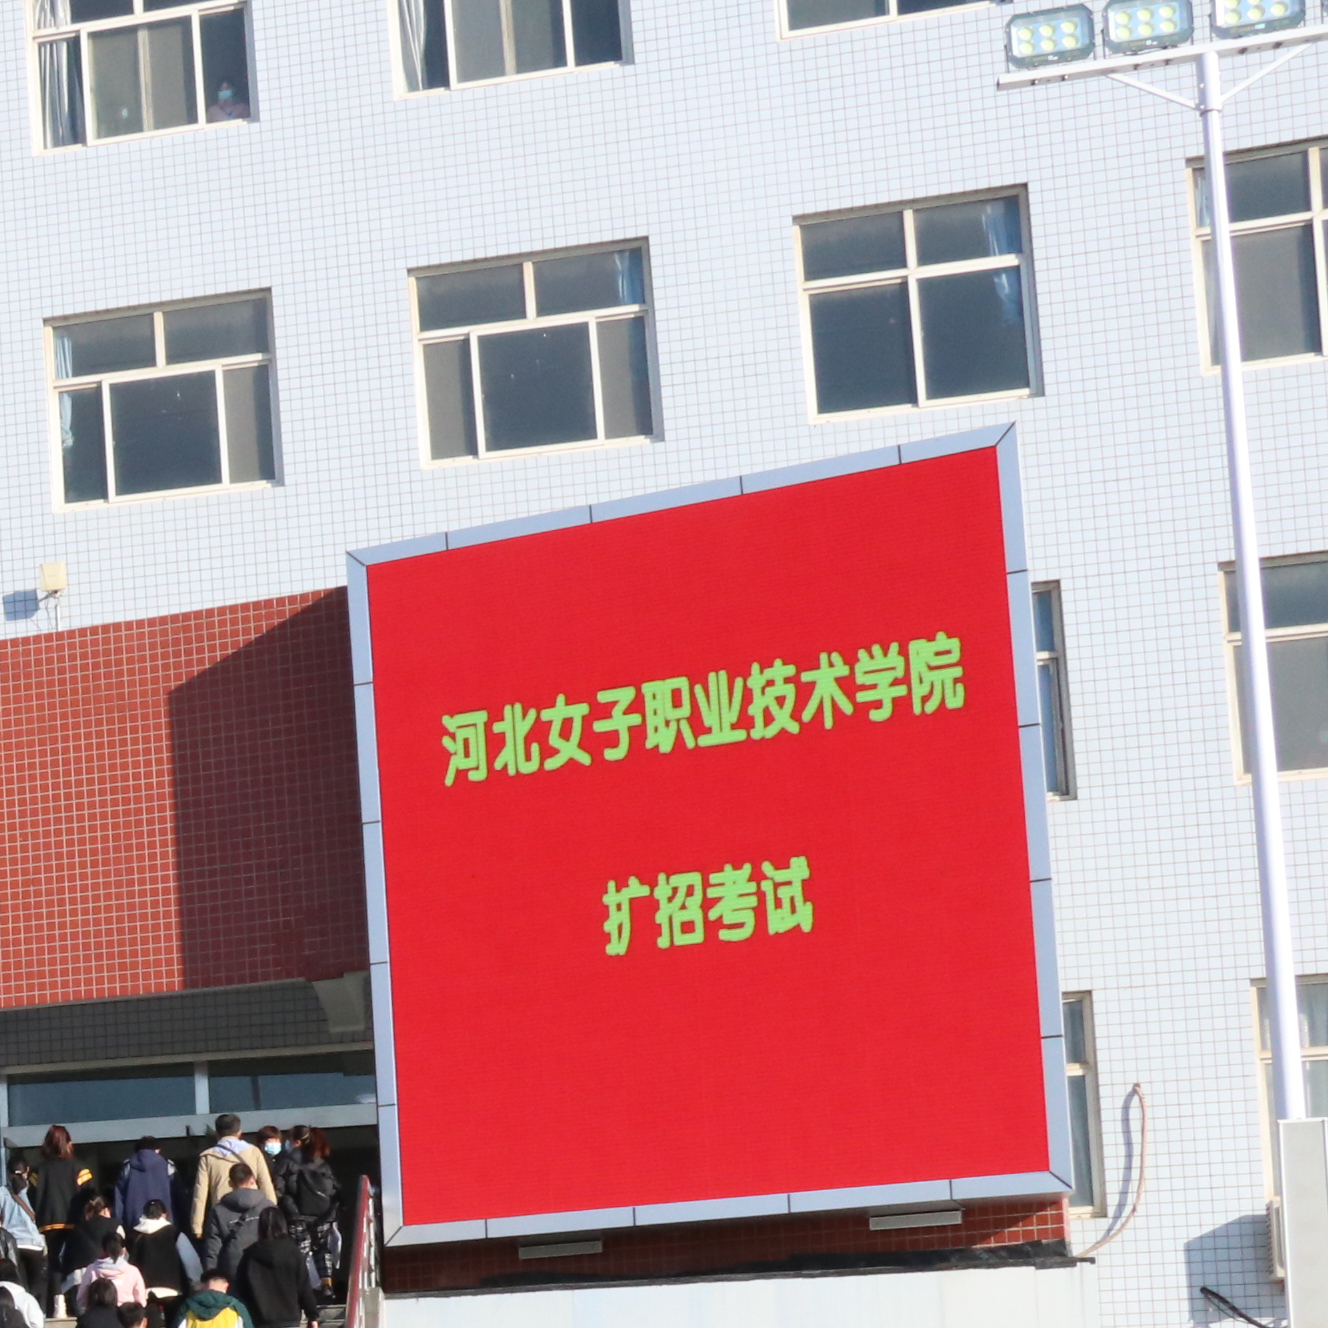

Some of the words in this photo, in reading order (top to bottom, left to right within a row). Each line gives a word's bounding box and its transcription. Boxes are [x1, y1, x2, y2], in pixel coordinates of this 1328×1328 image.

[441, 631, 965, 787] 河北女子职业技术学院
[603, 855, 814, 957] 扩招考试
